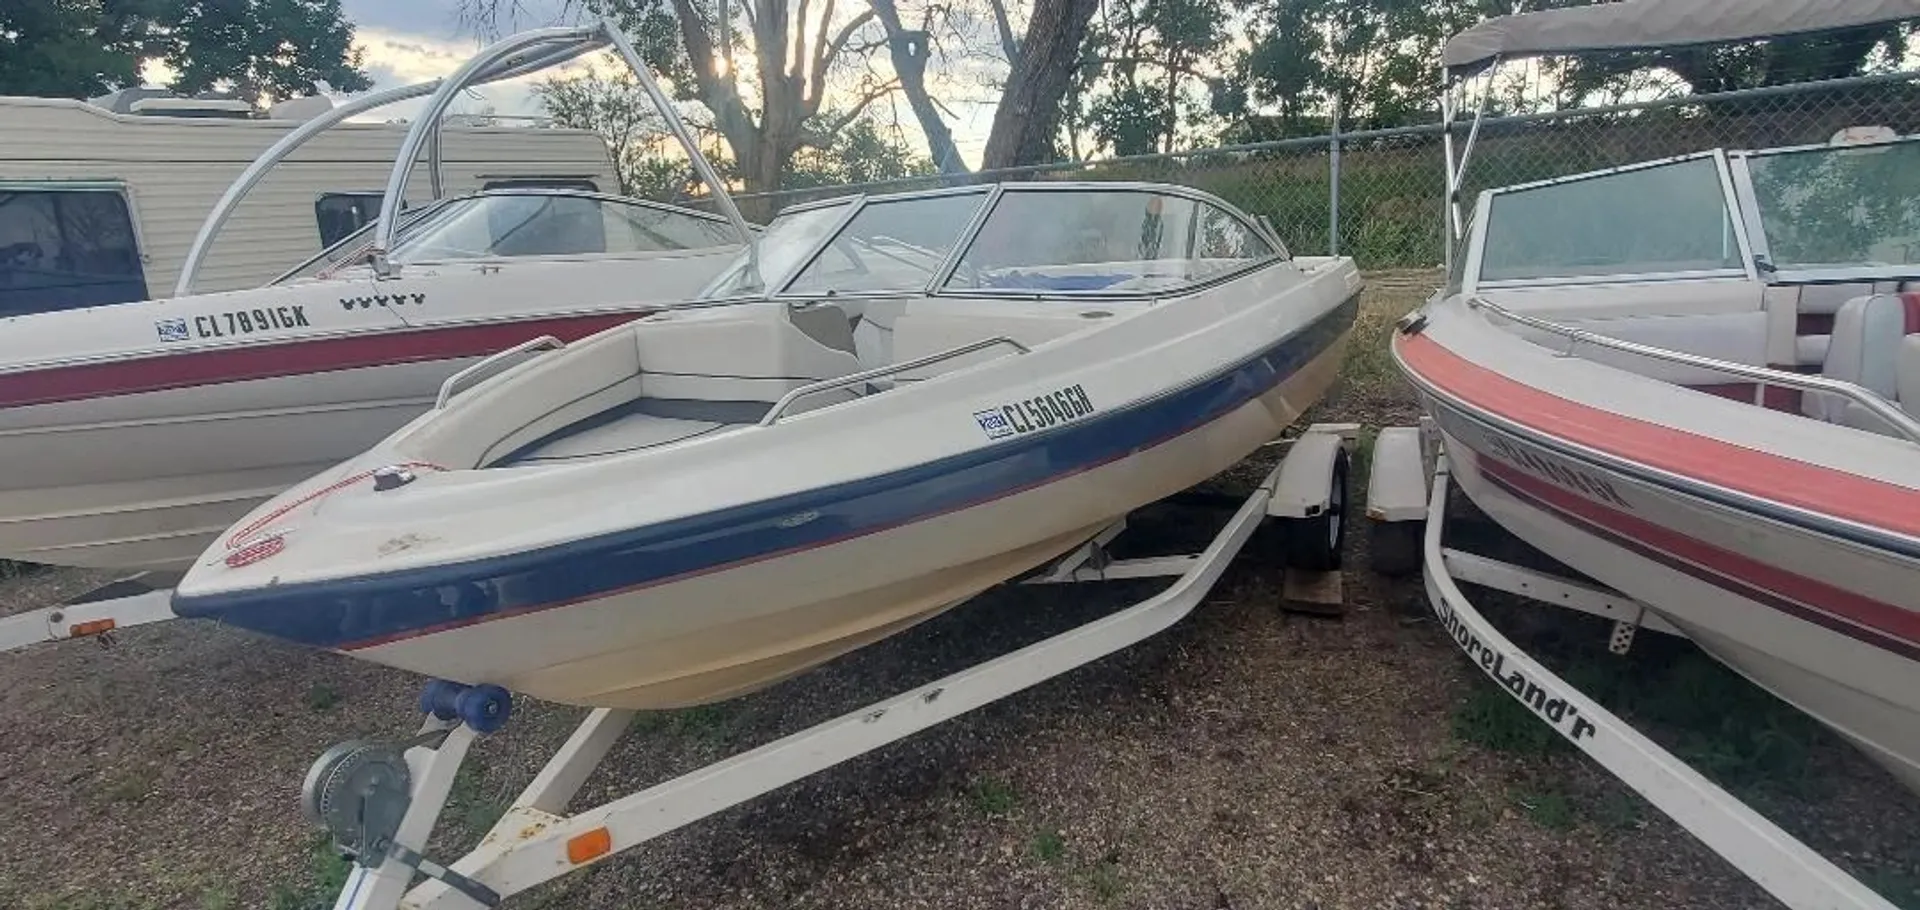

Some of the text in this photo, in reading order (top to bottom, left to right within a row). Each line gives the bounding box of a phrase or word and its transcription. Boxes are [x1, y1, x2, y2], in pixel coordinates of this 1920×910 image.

[194, 305, 311, 338] CL7891GK
[1002, 383, 1095, 433] CL5646GH
[1439, 597, 1596, 740] ShoreLand'r
